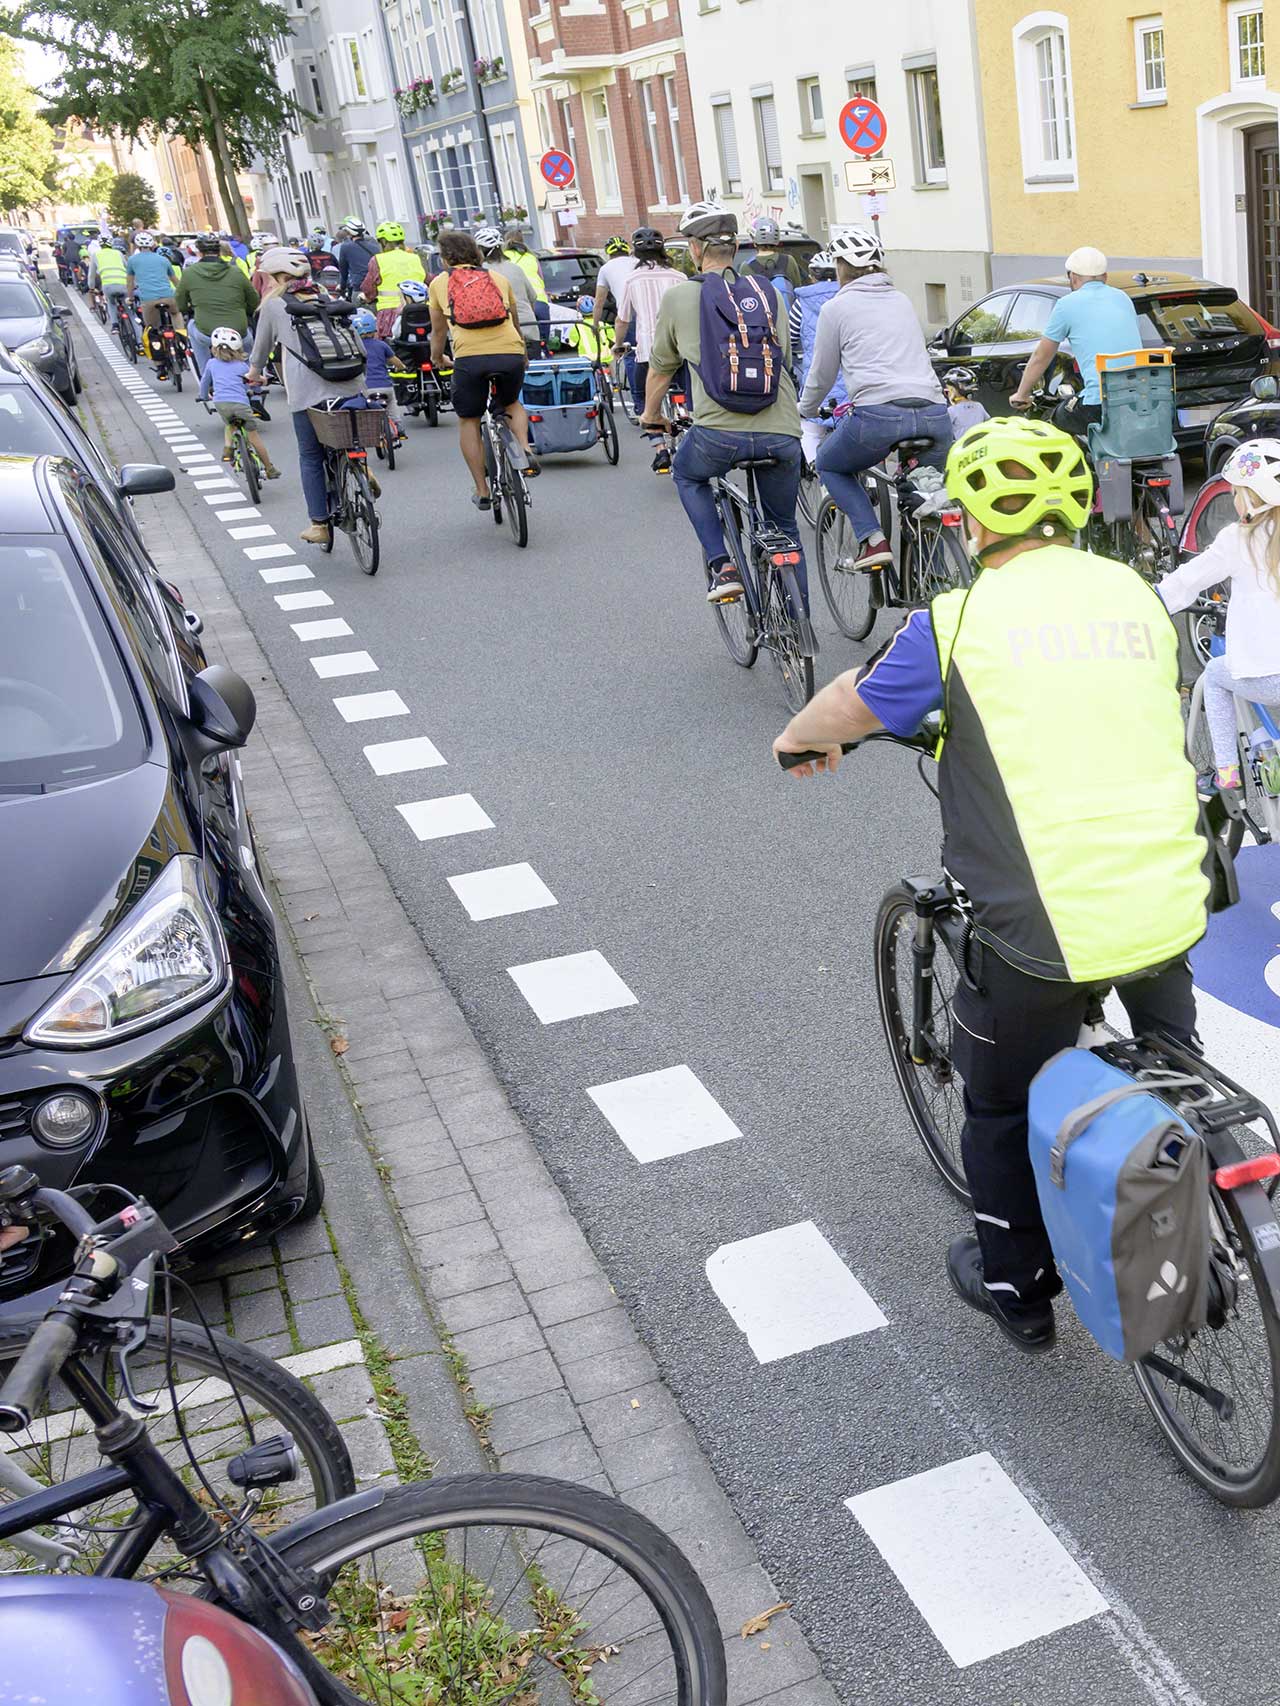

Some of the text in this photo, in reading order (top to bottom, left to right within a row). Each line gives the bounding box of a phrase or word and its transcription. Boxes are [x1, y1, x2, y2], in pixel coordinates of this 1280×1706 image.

[1185, 341, 1240, 352] OLVO
[958, 446, 987, 472] POLIZEI
[1007, 621, 1157, 667] POLIZEI
